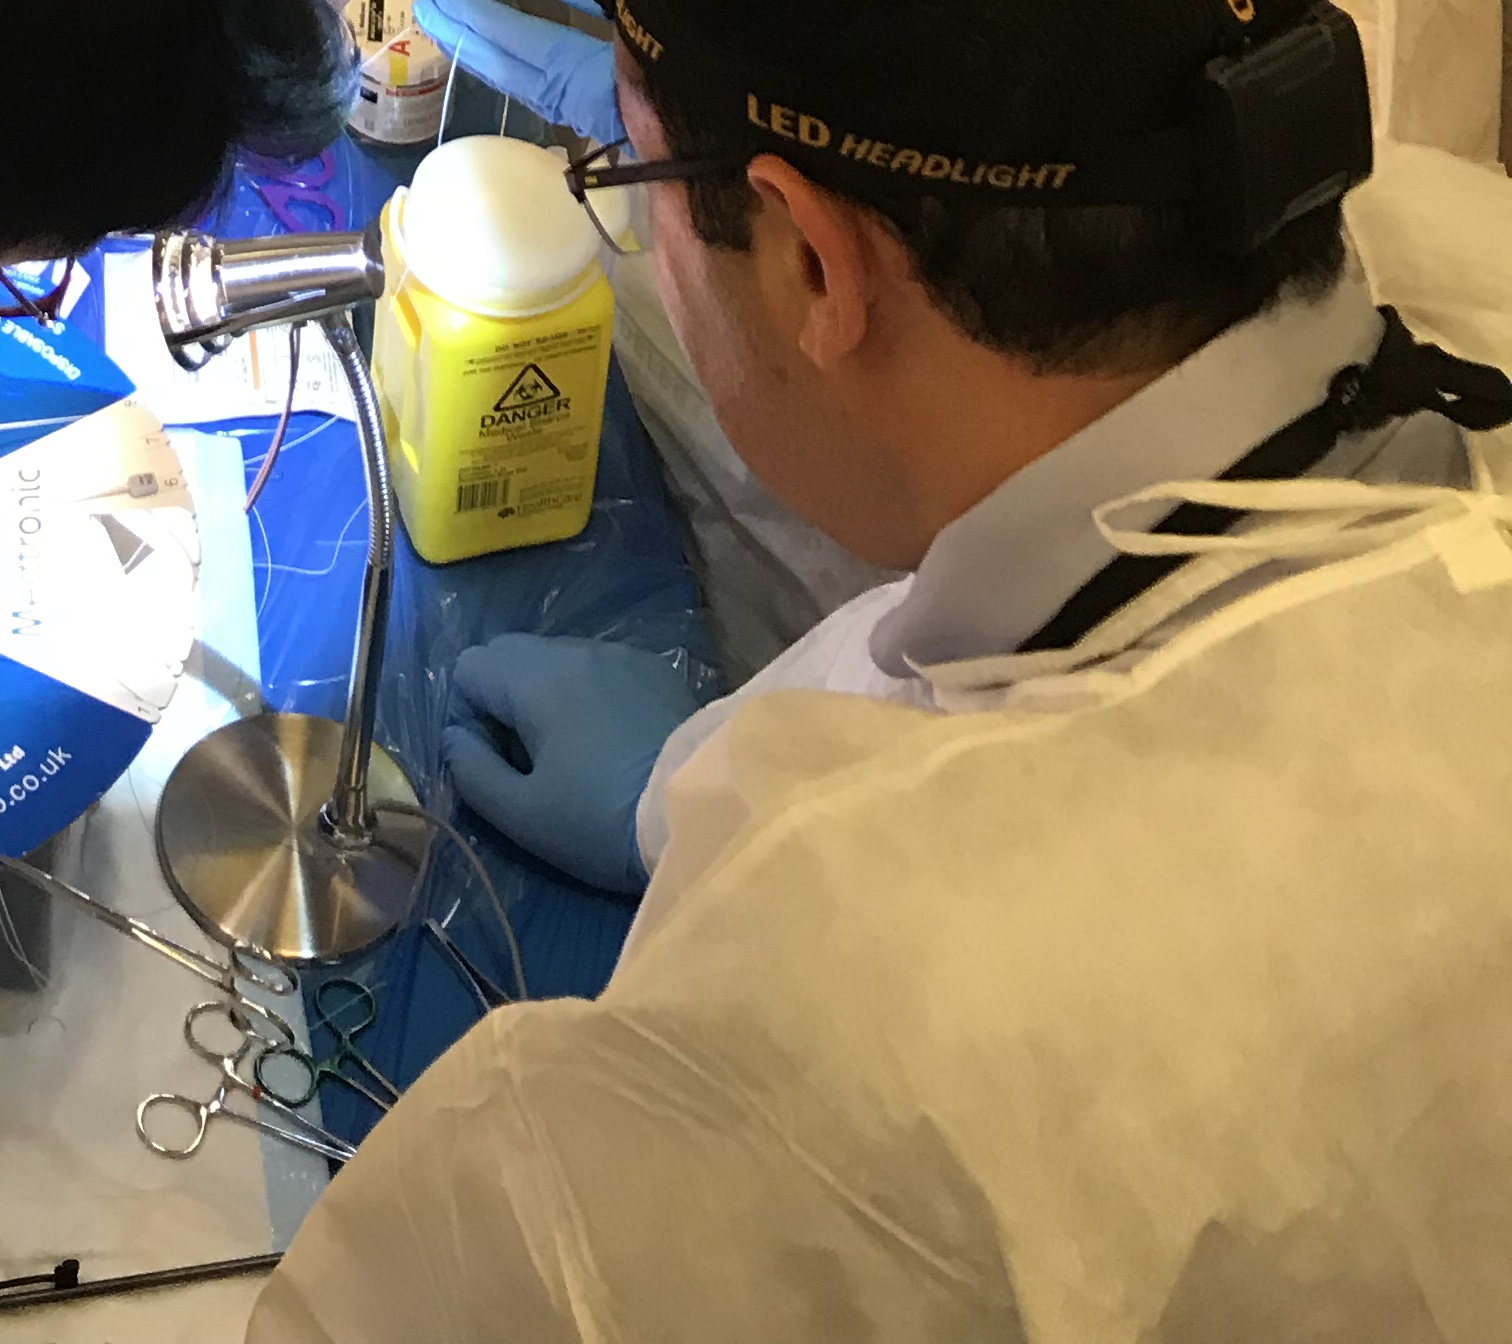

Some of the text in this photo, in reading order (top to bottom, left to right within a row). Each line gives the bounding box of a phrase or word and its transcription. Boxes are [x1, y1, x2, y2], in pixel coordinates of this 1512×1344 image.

[390, 39, 412, 57] A
[746, 90, 1077, 190] LED HEADLIGHT
[1, 318, 82, 381] DISPOSABLE
[480, 397, 571, 429] DANGER
[163, 476, 179, 488] 6
